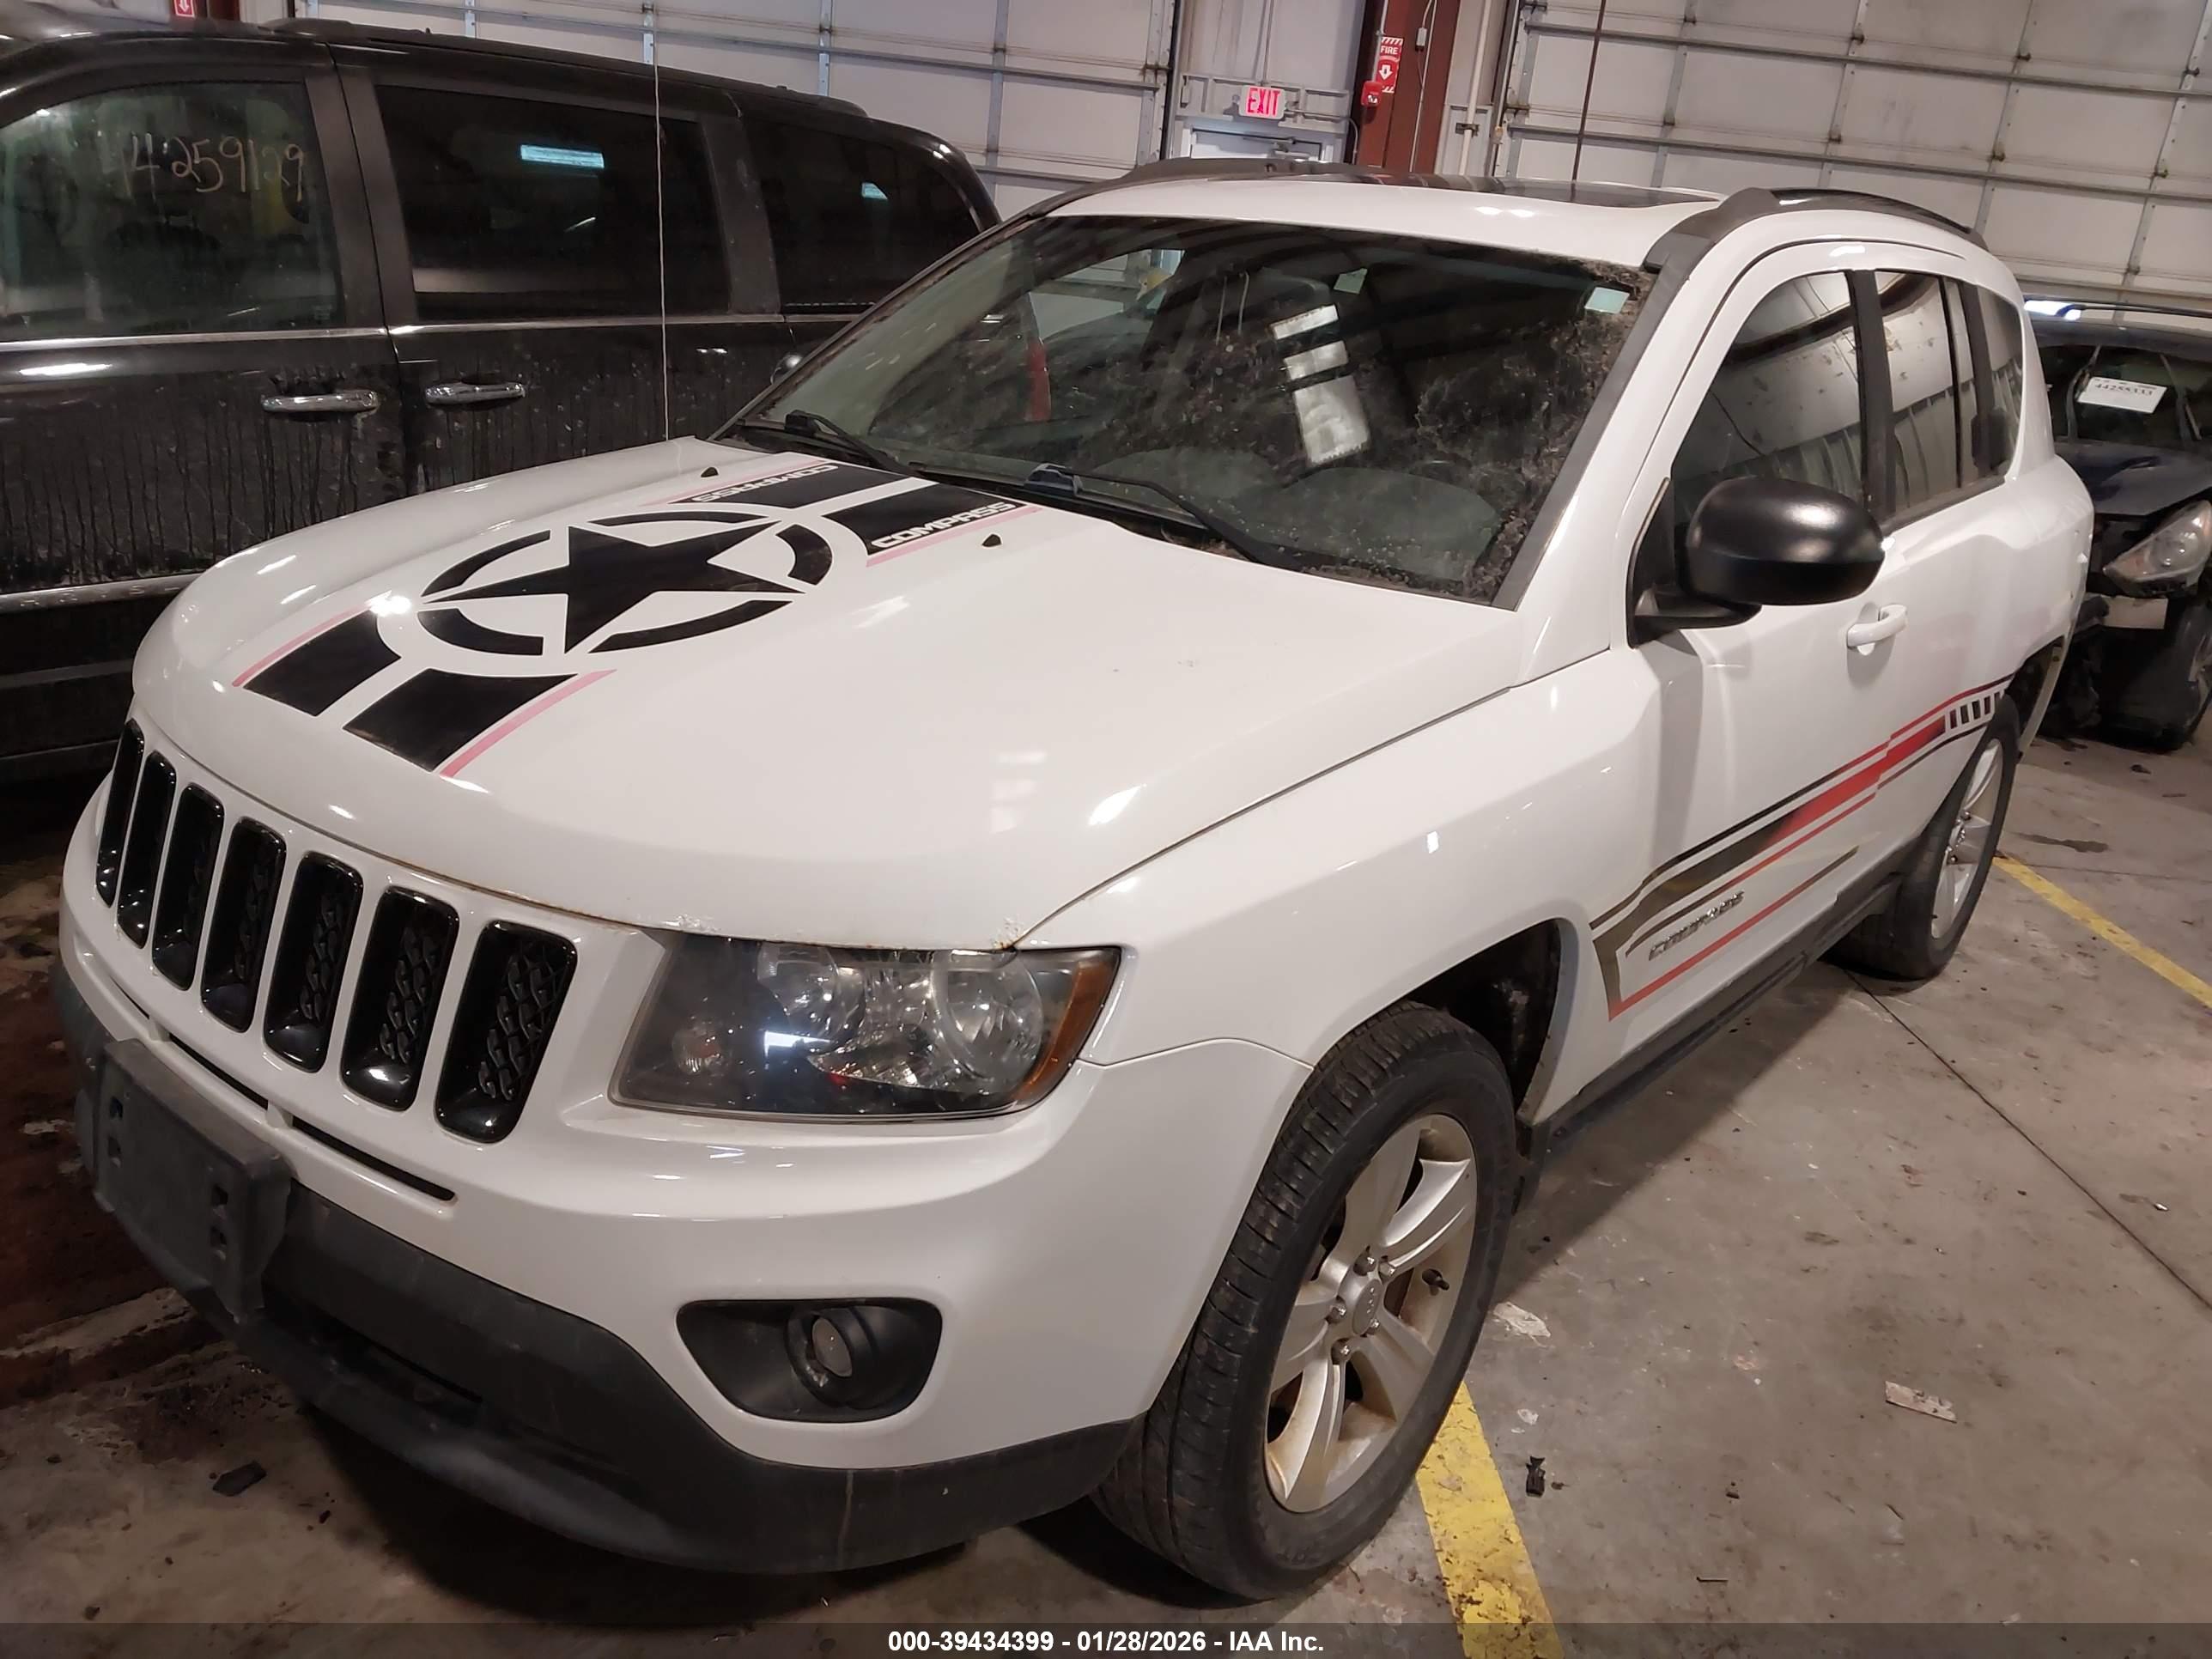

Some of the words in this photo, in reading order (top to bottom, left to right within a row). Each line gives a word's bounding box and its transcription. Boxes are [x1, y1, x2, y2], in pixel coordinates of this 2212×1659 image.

[1380, 46, 1399, 55] FIRE
[1248, 88, 1280, 115] EXIT
[691, 465, 839, 502] COMPASS
[871, 501, 1017, 548] COMPASS
